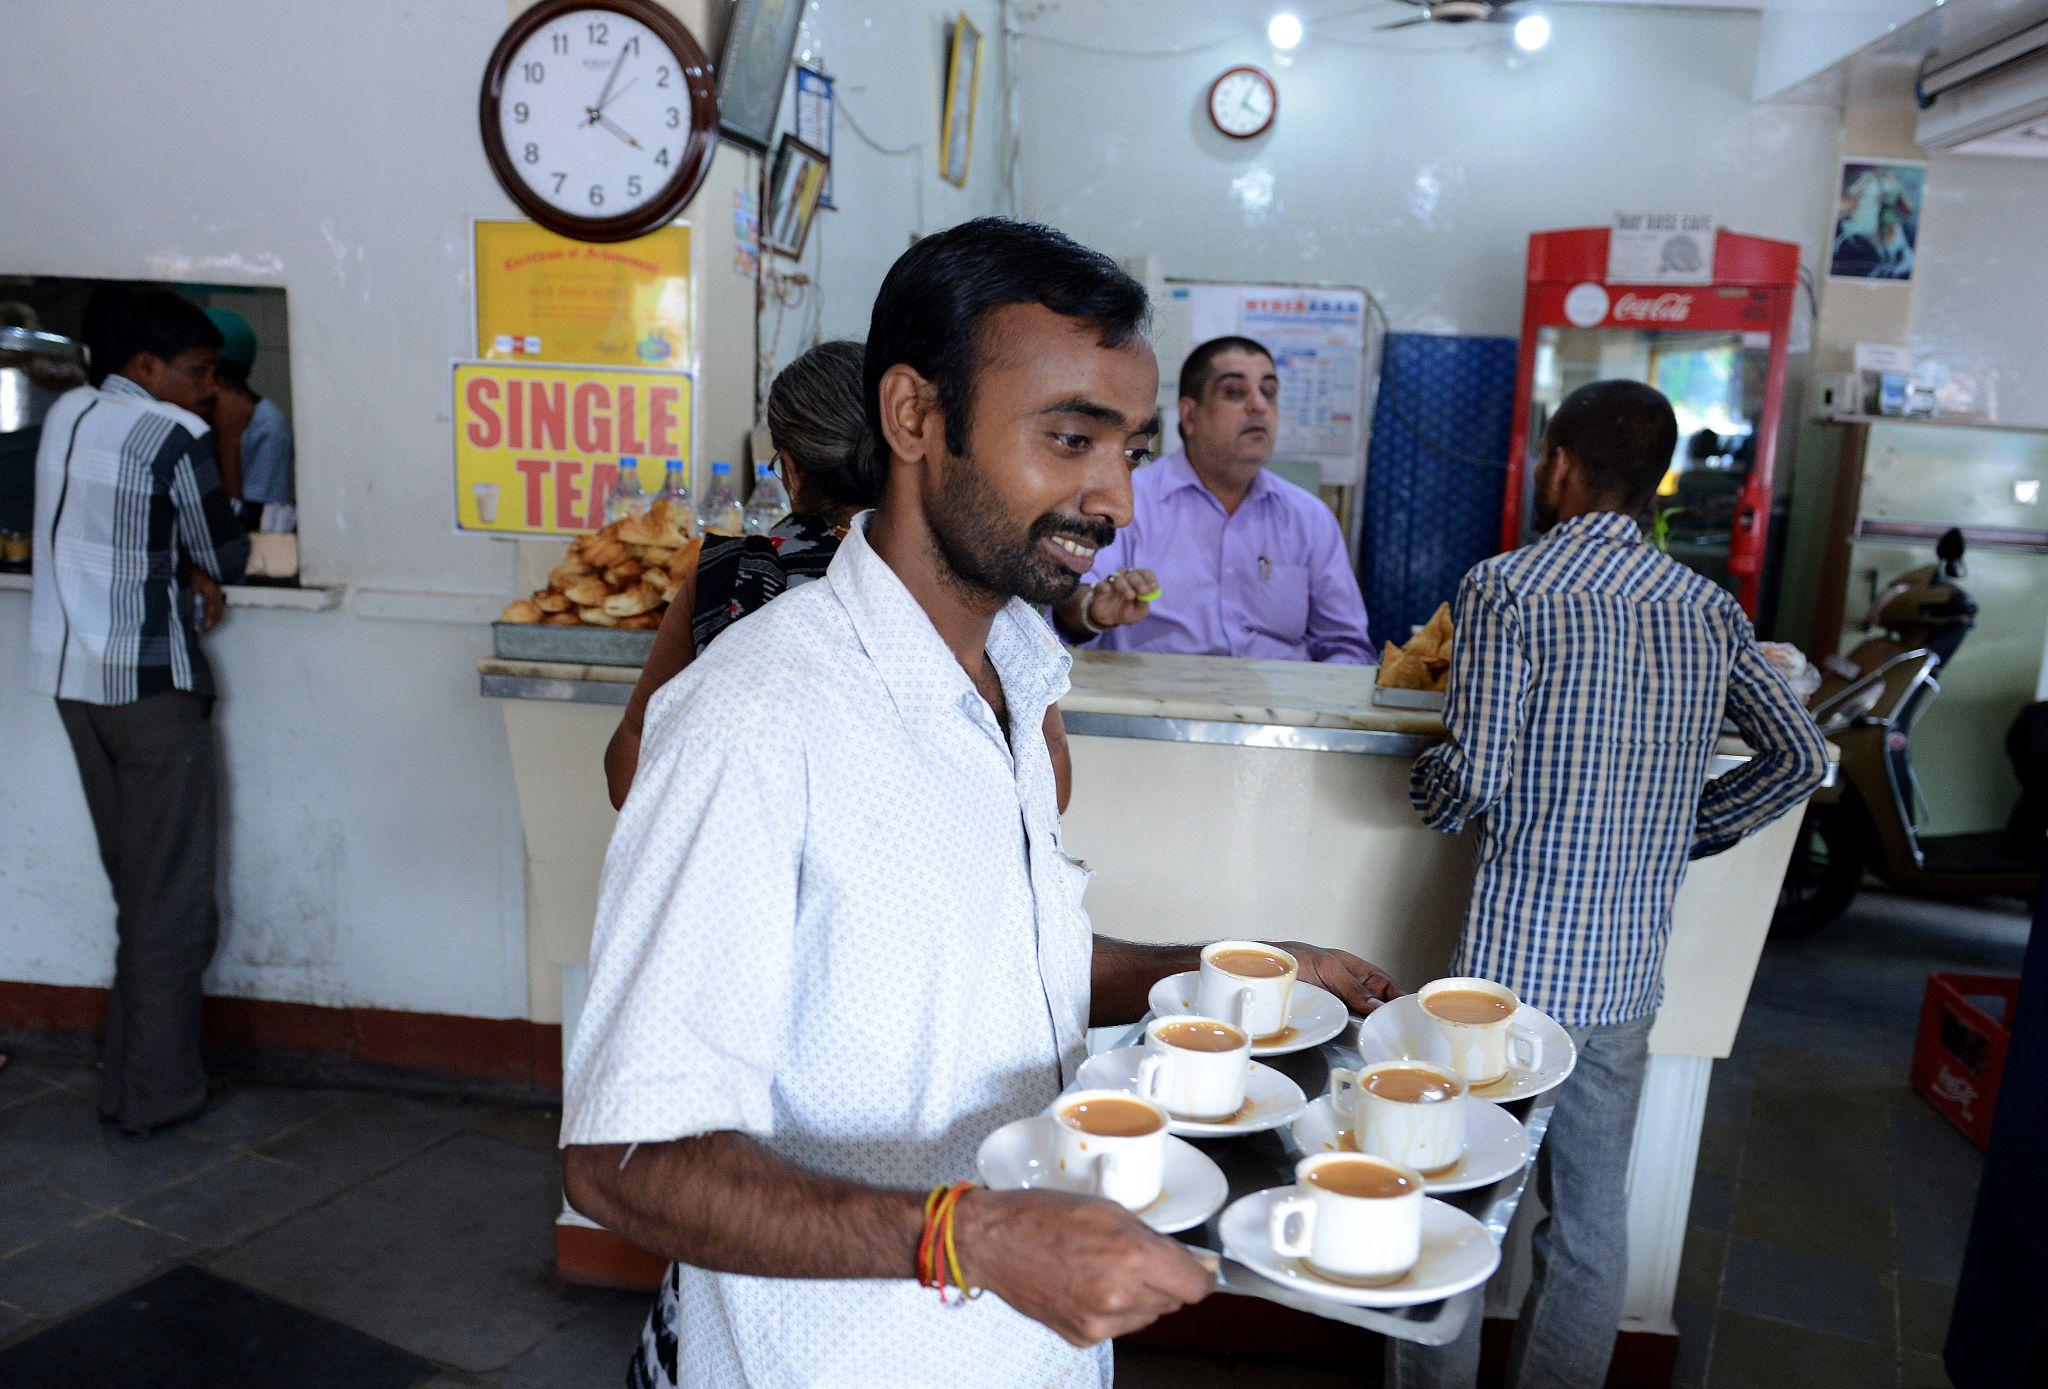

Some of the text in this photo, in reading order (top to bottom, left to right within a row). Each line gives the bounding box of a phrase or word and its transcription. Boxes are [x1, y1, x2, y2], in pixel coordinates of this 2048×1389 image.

[587, 22, 609, 45] 12
[552, 35, 568, 54] 11
[630, 36, 640, 55] 1
[523, 62, 544, 84] 10
[656, 66, 670, 87] 2
[514, 102, 529, 123] 9
[666, 107, 680, 128] 3
[525, 143, 539, 164] 8
[654, 149, 668, 168] 4
[552, 173, 566, 193] 7
[627, 176, 642, 197] 5
[589, 185, 604, 206] 6
[466, 377, 680, 457] SINGLE
